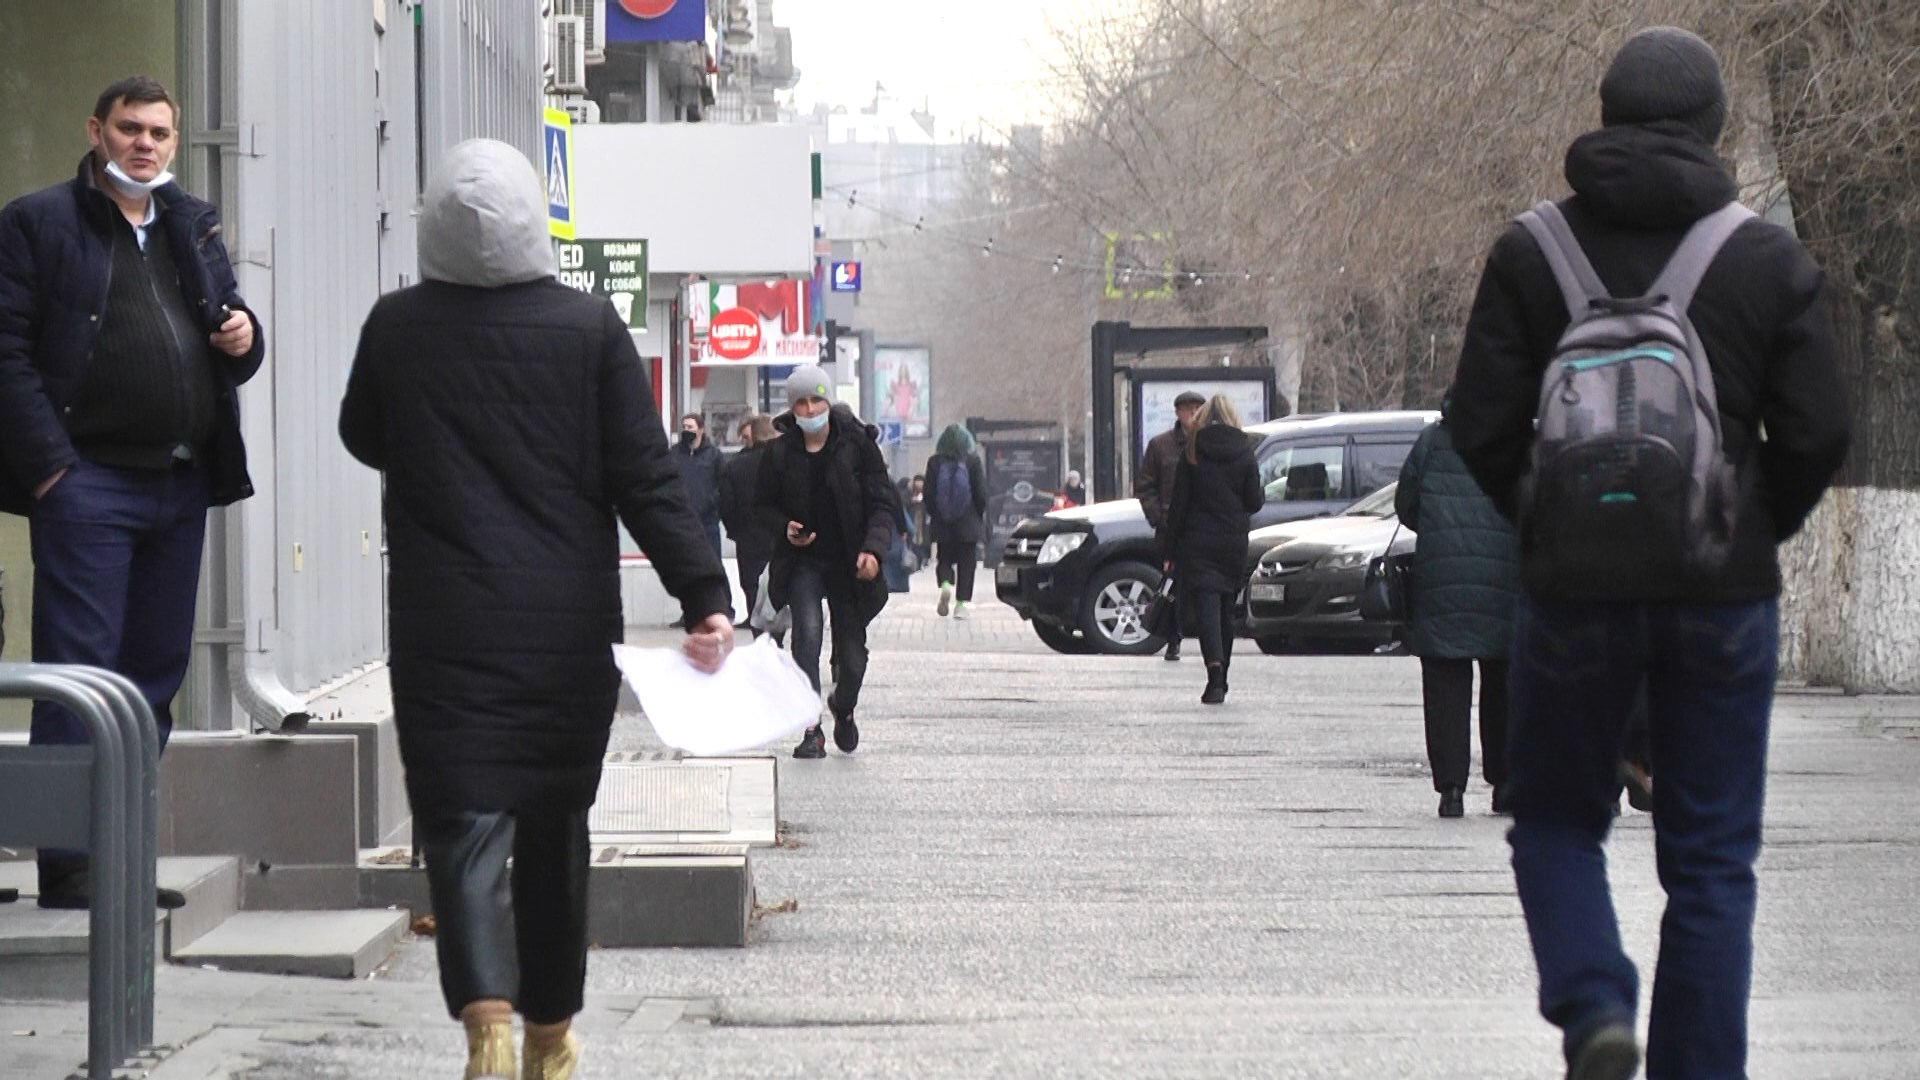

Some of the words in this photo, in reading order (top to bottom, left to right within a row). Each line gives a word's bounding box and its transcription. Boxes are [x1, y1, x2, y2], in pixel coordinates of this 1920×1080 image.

[604, 243, 641, 256] ВОЗЬМИ
[610, 260, 635, 272] КОФЕ
[604, 278, 610, 291] С
[612, 276, 642, 291] СОБОЙ
[712, 323, 758, 339] ЦВЕТЫ
